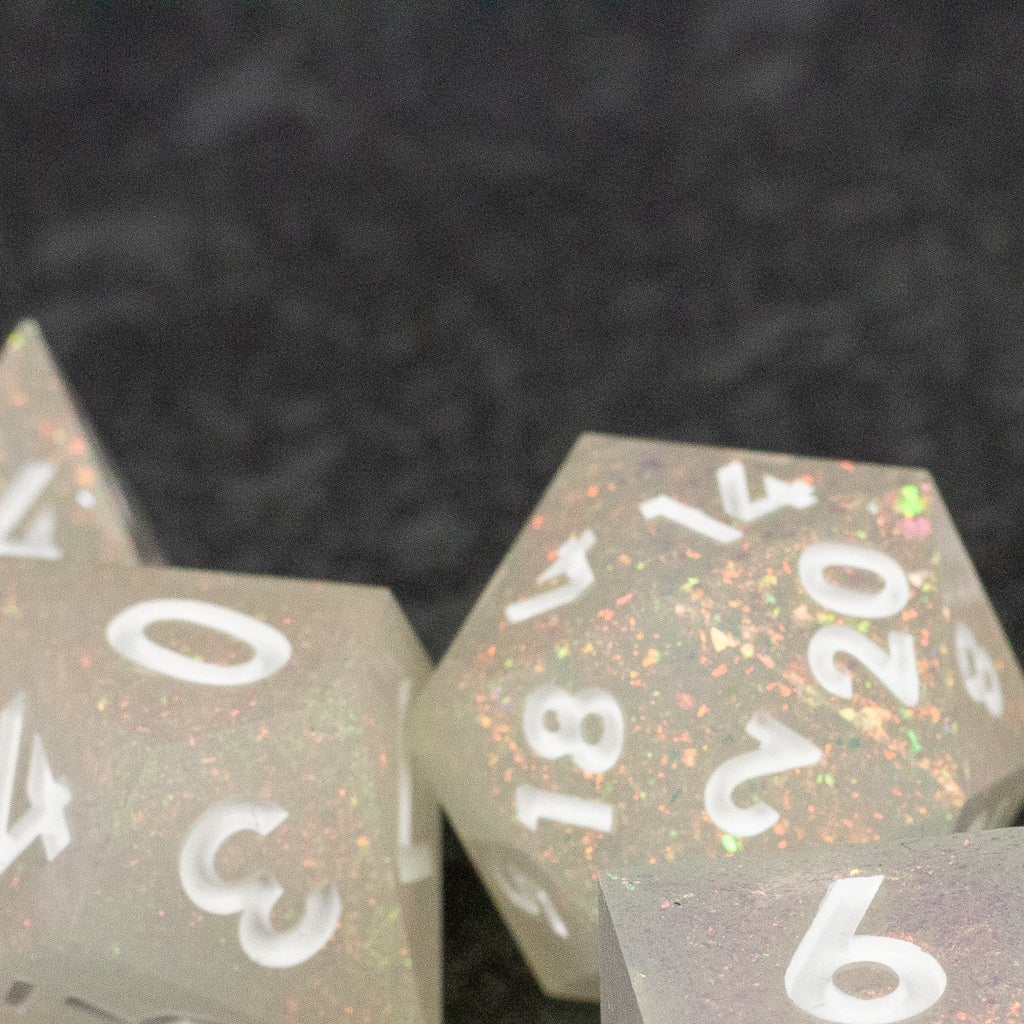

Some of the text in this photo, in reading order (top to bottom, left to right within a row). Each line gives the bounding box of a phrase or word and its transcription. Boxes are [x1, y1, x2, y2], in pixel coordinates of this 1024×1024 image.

[640, 461, 818, 545] 14
[504, 529, 597, 625] 4
[798, 541, 919, 708] 20
[105, 599, 293, 687] 0
[514, 684, 626, 833] 18
[703, 712, 825, 839] 2
[179, 802, 343, 969] 3
